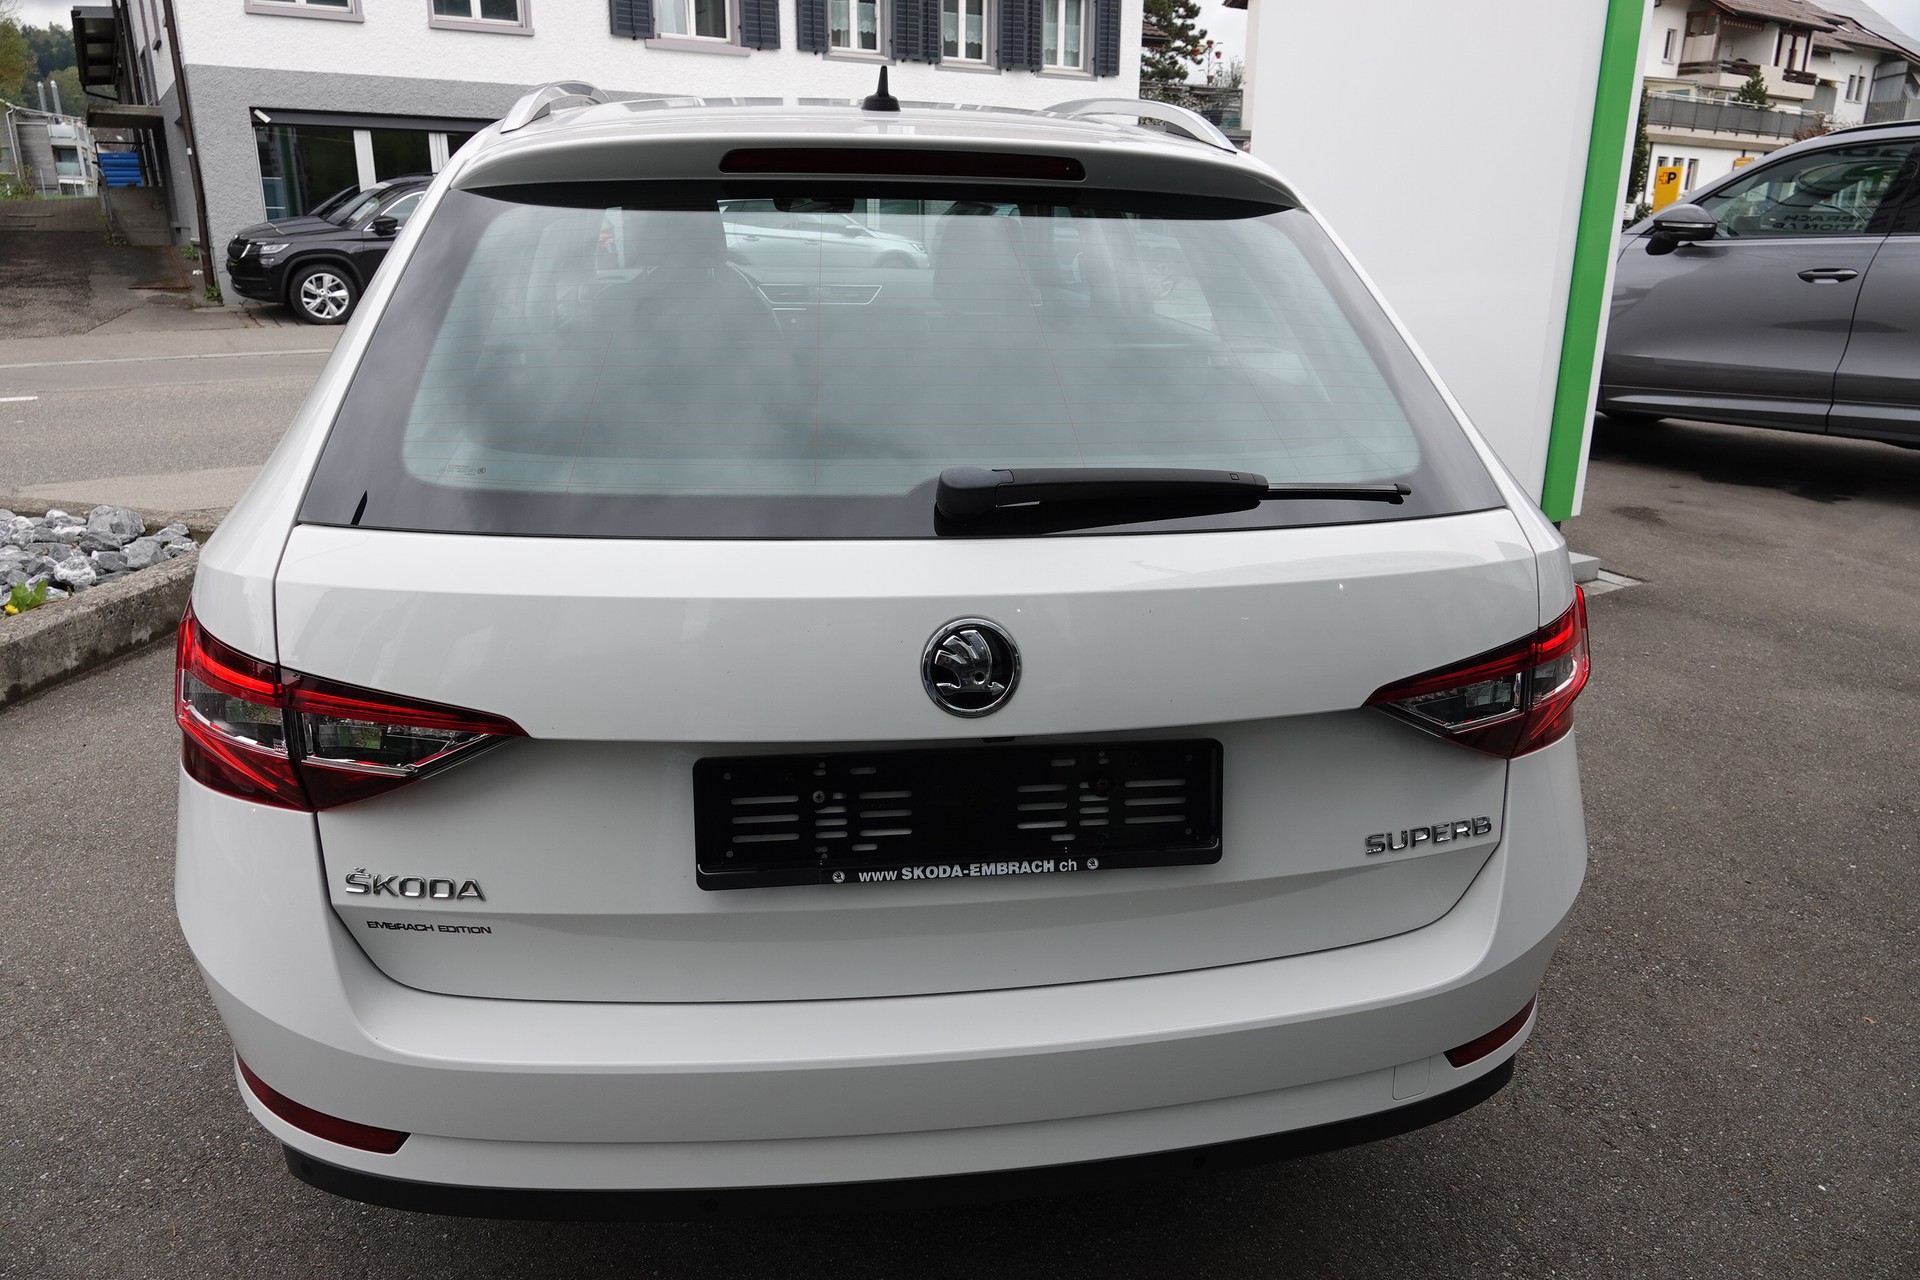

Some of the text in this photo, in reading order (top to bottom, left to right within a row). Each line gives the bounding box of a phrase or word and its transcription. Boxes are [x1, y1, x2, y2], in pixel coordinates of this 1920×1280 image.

[1667, 172, 1677, 184] P
[1365, 815, 1492, 855] SUPERB
[901, 860, 1055, 880] SKODA-EMBRACH
[1059, 859, 1077, 872] ch
[345, 867, 486, 902] ŠKODA
[366, 920, 492, 935] EMBRACH EDITION
